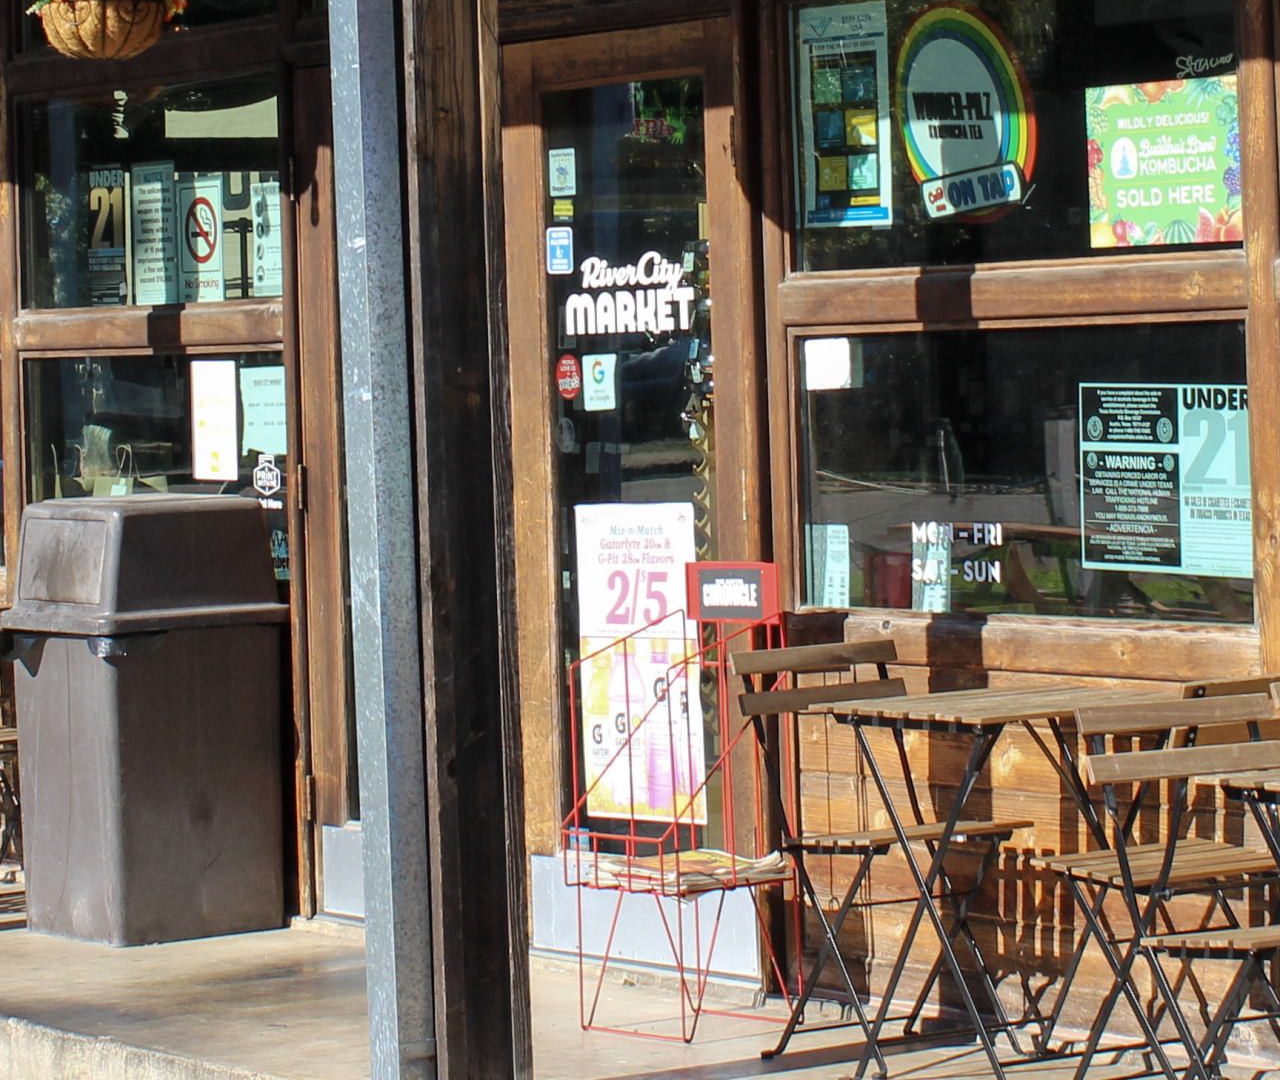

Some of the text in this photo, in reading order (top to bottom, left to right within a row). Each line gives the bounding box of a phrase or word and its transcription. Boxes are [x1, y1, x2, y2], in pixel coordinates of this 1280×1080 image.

[1117, 112, 1210, 130] WILDLY DELICIOUS!
[969, 125, 983, 140] TEA
[1186, 134, 1217, 155] Brew
[1139, 156, 1217, 176] KOMBUCHA
[89, 170, 124, 188] UNDER
[948, 179, 977, 208] ON
[978, 170, 1015, 202] TAP
[1116, 184, 1216, 208] SOLD HERE
[90, 186, 121, 249] 21
[185, 279, 219, 290] No Smoking
[565, 286, 695, 336] MARKET
[1182, 388, 1249, 410] UNDER
[1183, 409, 1251, 486] 21
[1104, 455, 1156, 470] WARNING
[257, 470, 277, 481] PRINT
[911, 521, 1003, 546] MON FRI
[600, 538, 641, 553] Gatorlyte
[664, 538, 671, 549] &
[641, 552, 675, 564] Flavors
[911, 559, 1001, 584] SAT SUN
[702, 583, 758, 607] CHRONICLE
